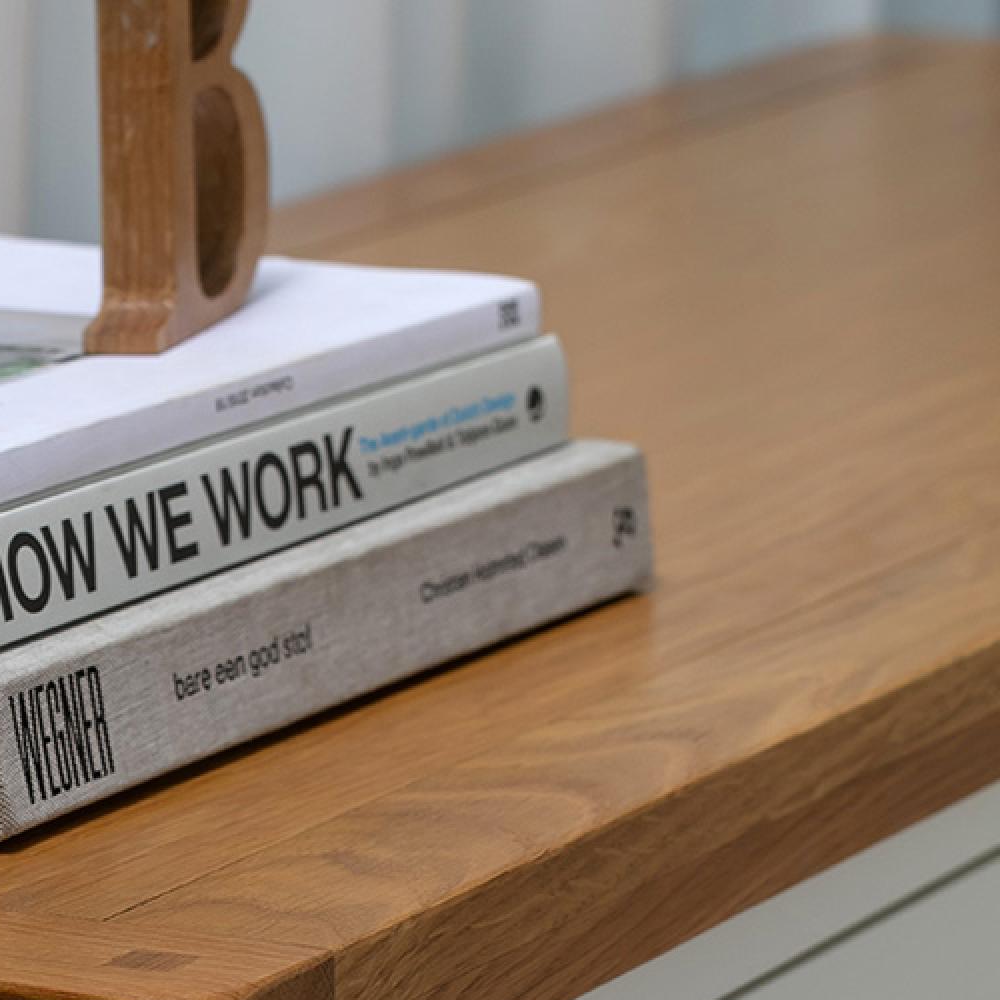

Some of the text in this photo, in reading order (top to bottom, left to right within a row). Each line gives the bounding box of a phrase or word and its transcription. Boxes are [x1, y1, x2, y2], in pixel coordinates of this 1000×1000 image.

[104, 481, 199, 579] WE
[201, 426, 364, 547] WORK
[8, 665, 116, 805] WEGNER
[172, 665, 212, 701] bare
[215, 654, 247, 686] een
[250, 636, 281, 677] god
